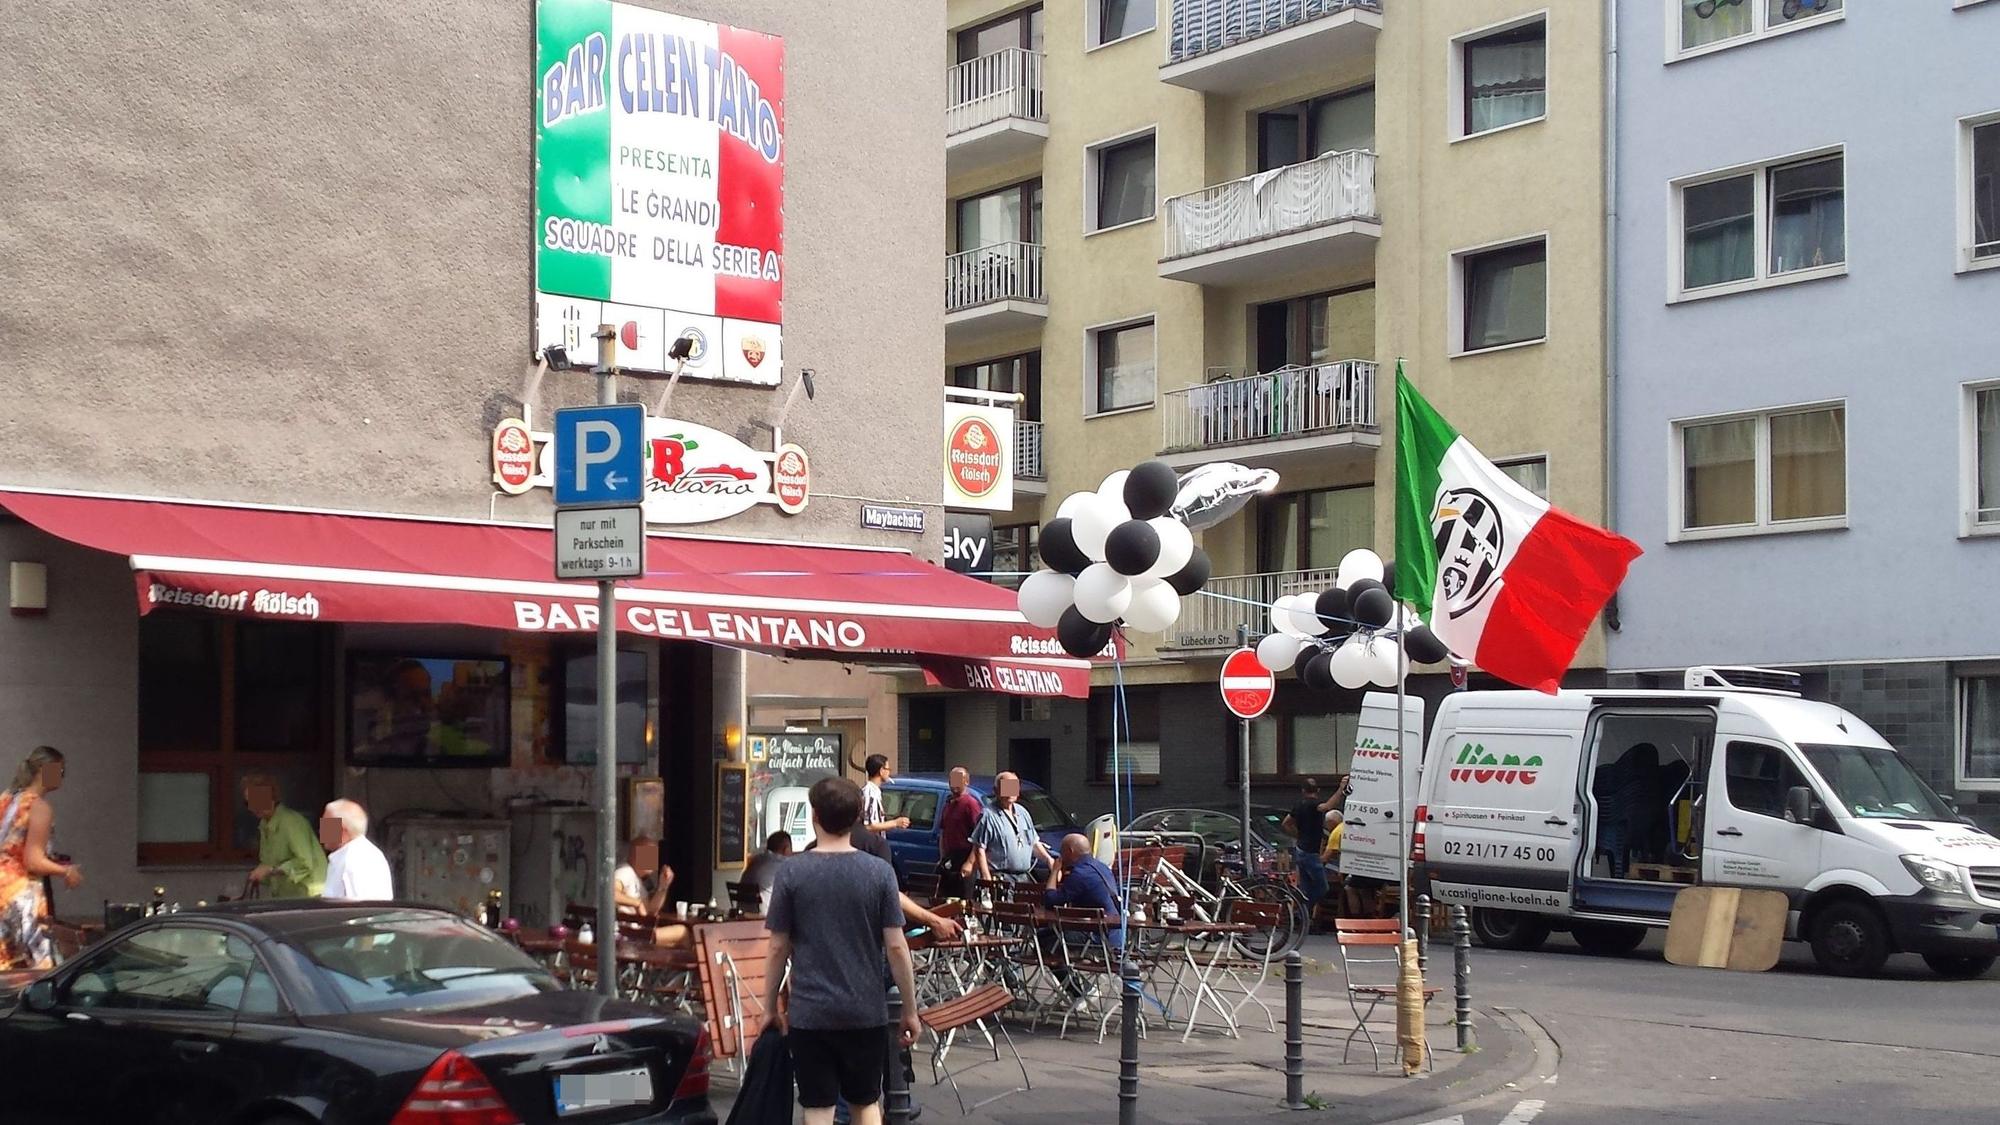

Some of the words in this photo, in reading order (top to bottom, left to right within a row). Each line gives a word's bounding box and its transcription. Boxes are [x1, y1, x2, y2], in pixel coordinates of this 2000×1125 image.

[546, 33, 605, 124] BAR
[618, 33, 778, 160] CELENTANO
[620, 146, 711, 179] PRESENTA
[621, 188, 639, 214] LE
[647, 191, 716, 228] GRANDI
[547, 219, 637, 259] SQUADRE
[653, 237, 704, 268] DELLA
[712, 245, 759, 276] SERIE
[765, 253, 778, 279] A
[575, 421, 621, 491] P
[652, 439, 685, 488] B
[952, 448, 1000, 467] Reissdorf
[960, 466, 991, 483] Kölsch
[580, 520, 596, 530] nur
[600, 516, 617, 530] mit
[573, 536, 624, 550] Parkschein
[944, 528, 986, 568] sky
[561, 557, 604, 572] werktags
[148, 583, 249, 611] Reissdorf
[252, 589, 320, 620] Kölsch
[513, 600, 599, 630] BAR
[627, 606, 866, 648] CELENTANO
[1010, 635, 1067, 656] Reissdo
[1181, 634, 1216, 647] Lübecker
[1217, 634, 1230, 645] Str
[964, 664, 995, 690] BAR
[995, 666, 1063, 695] CELENTANO
[768, 752, 803, 774] einfach
[1359, 805, 1368, 814] 45
[1369, 807, 1379, 815] 00
[1452, 811, 1488, 821] Spirituosen
[1497, 812, 1526, 822] Feinkost
[1348, 833, 1376, 845] Catering
[1444, 841, 1461, 855] 02
[1466, 842, 1509, 859] 21/17
[1513, 846, 1532, 861] 45
[1536, 847, 1556, 862] 00
